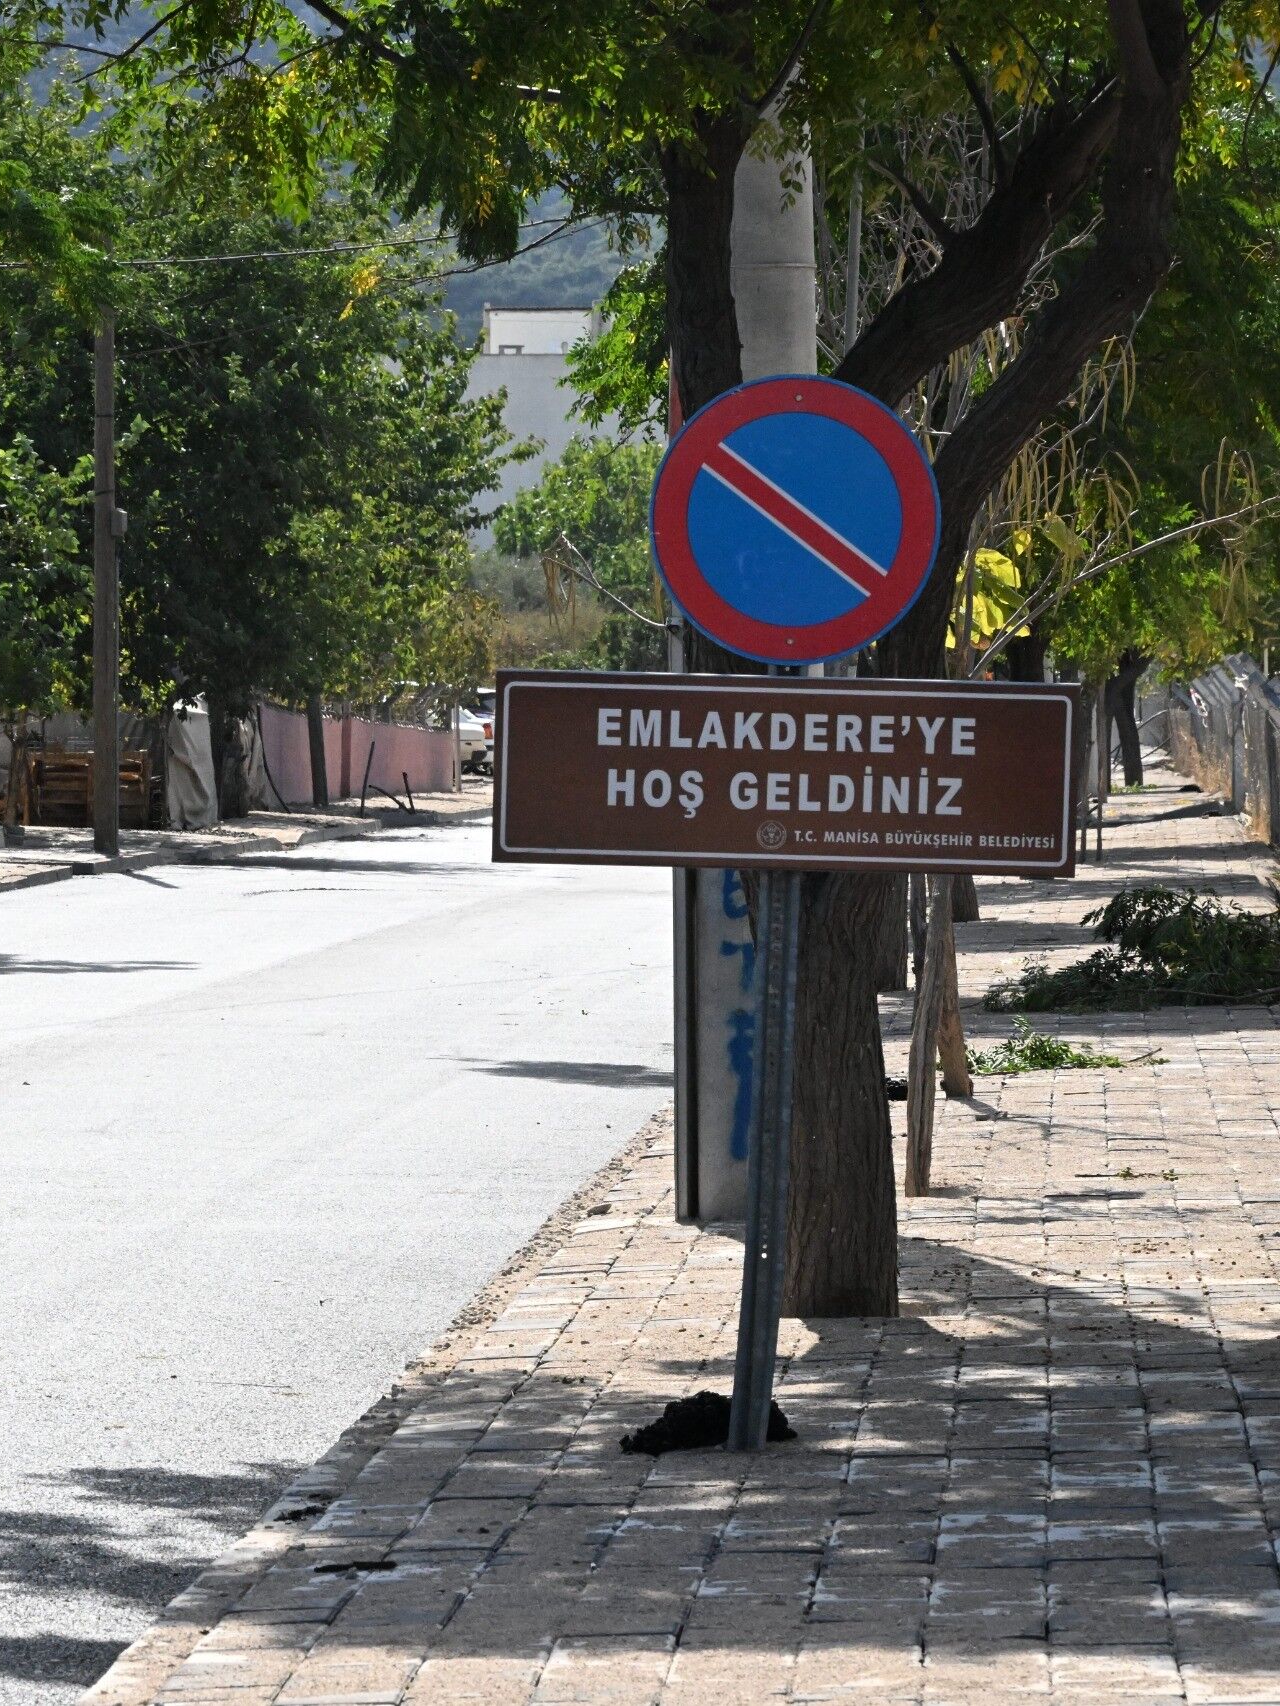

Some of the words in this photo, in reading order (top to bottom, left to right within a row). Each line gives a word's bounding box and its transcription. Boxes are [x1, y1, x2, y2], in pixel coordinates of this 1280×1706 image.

[597, 708, 976, 756] EMLAKDERE'YE
[607, 768, 704, 819] HOŞ
[729, 765, 963, 816] GELDİNİZ
[794, 830, 818, 843] T.C.
[823, 828, 880, 844] MANİSA
[885, 829, 973, 849] BÜYÜKŞEHİR
[979, 832, 1055, 849] BELEDİYESİ
